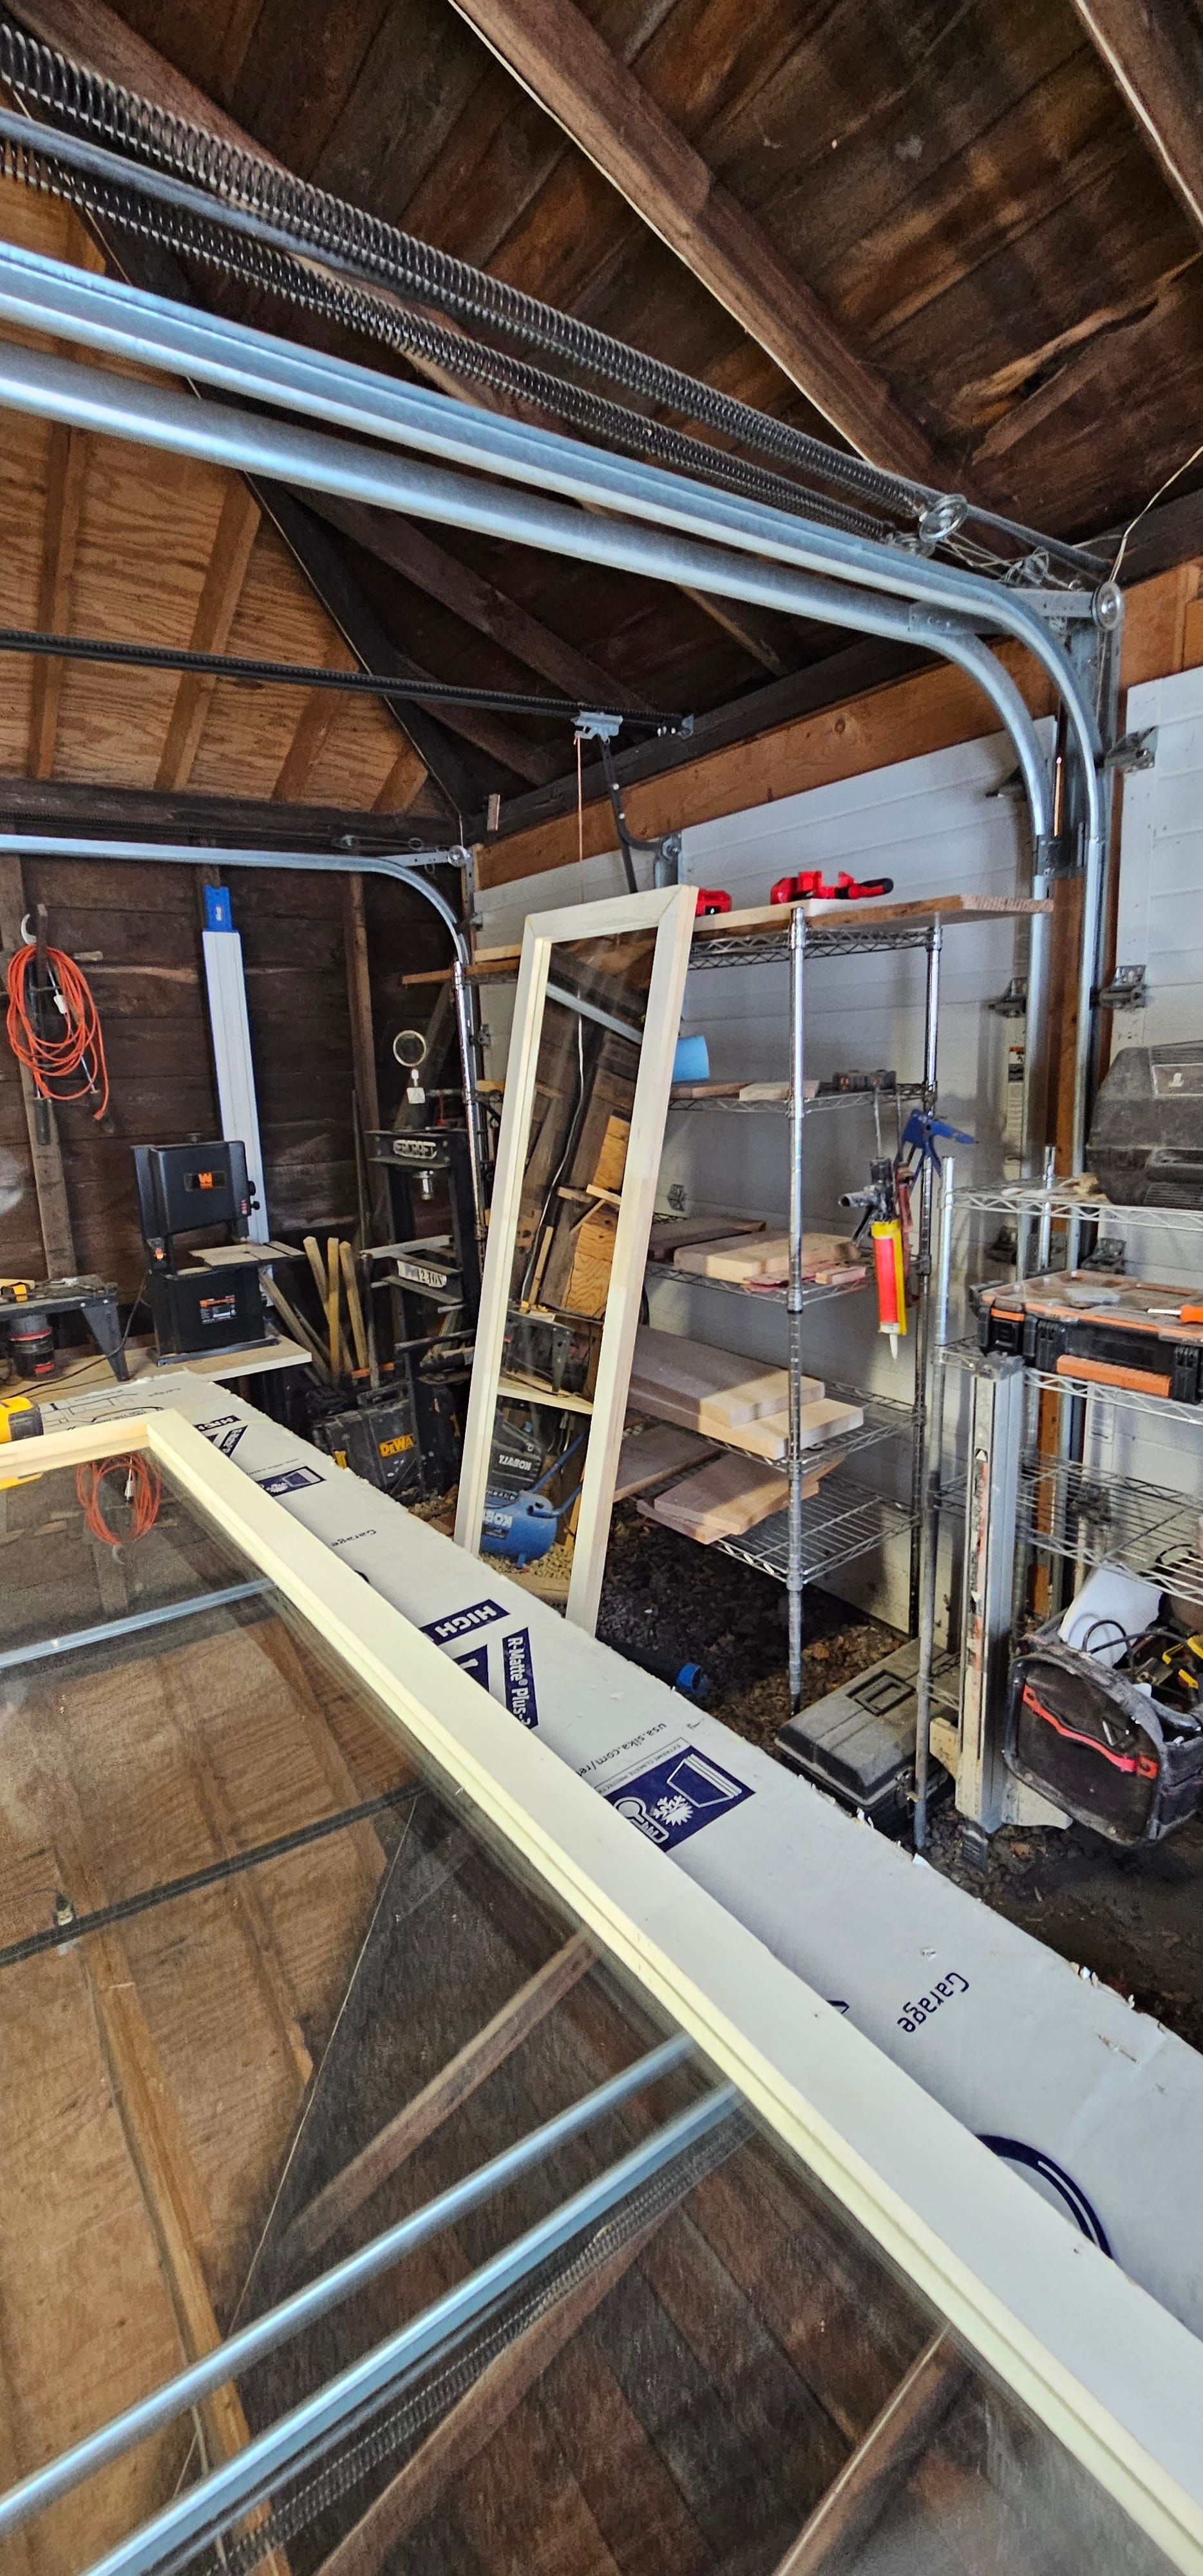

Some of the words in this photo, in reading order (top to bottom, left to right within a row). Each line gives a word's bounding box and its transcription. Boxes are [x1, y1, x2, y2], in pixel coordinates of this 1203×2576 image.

[380, 1435, 414, 1457] DEWA
[330, 1529, 377, 1547] Garage
[435, 1605, 497, 1638] HIGH
[896, 1972, 970, 2032] Garage
